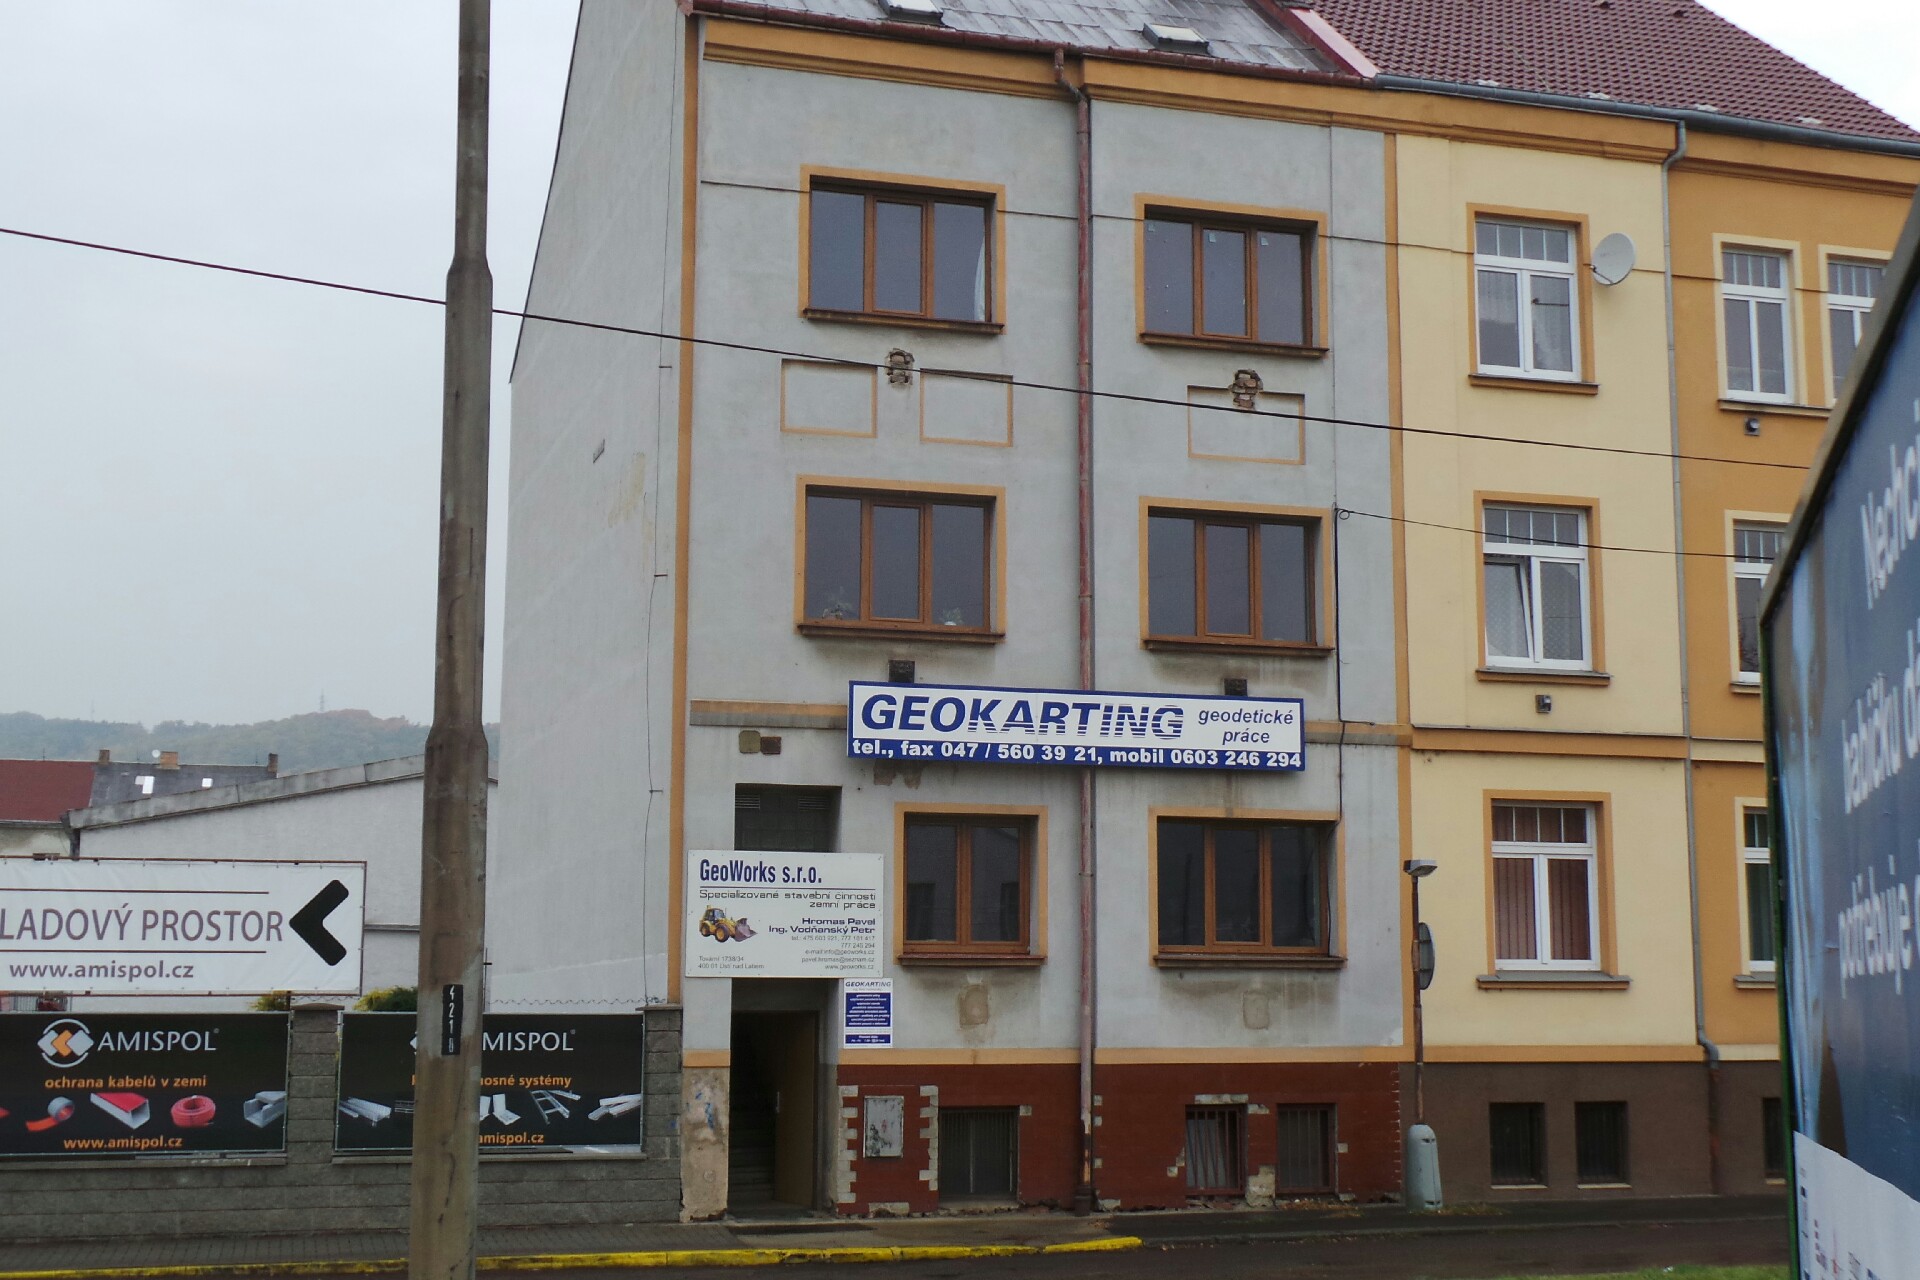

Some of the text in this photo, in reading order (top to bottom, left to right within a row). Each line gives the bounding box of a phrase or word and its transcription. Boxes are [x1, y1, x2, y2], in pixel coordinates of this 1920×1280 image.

[861, 694, 1184, 740] GEOKARTING
[1198, 708, 1293, 725] geodetické
[1222, 728, 1270, 745] práce
[852, 740, 894, 758] tel.,
[901, 740, 933, 756] fax
[941, 742, 979, 758] 047
[998, 744, 1034, 760] 560
[1041, 745, 1066, 761] 39
[1074, 746, 1103, 765] 21,
[1109, 748, 1164, 763] mobil
[1171, 749, 1218, 765] 0603
[1225, 750, 1260, 766] 246
[1266, 752, 1301, 767] 294
[700, 858, 822, 883] GeoWorks s.r.o.
[699, 889, 779, 901] Specializované
[784, 890, 830, 900] stavební
[809, 900, 876, 911] zemní práce
[0, 903, 283, 942] LADOVÝ PROSTOR
[768, 925, 876, 935] Ing. Vodňanský Petr
[802, 917, 876, 926] Hromas Pavel
[1838, 854, 1911, 1000] potřebuje
[9, 960, 194, 982] www.amispol.cz
[97, 1031, 216, 1051] AMISPOL
[482, 1032, 574, 1051] MISPOL
[44, 1075, 207, 1088] ochrana kabelů v zemi
[519, 1075, 571, 1089] systémy
[63, 1135, 182, 1150] www.amispol.cz
